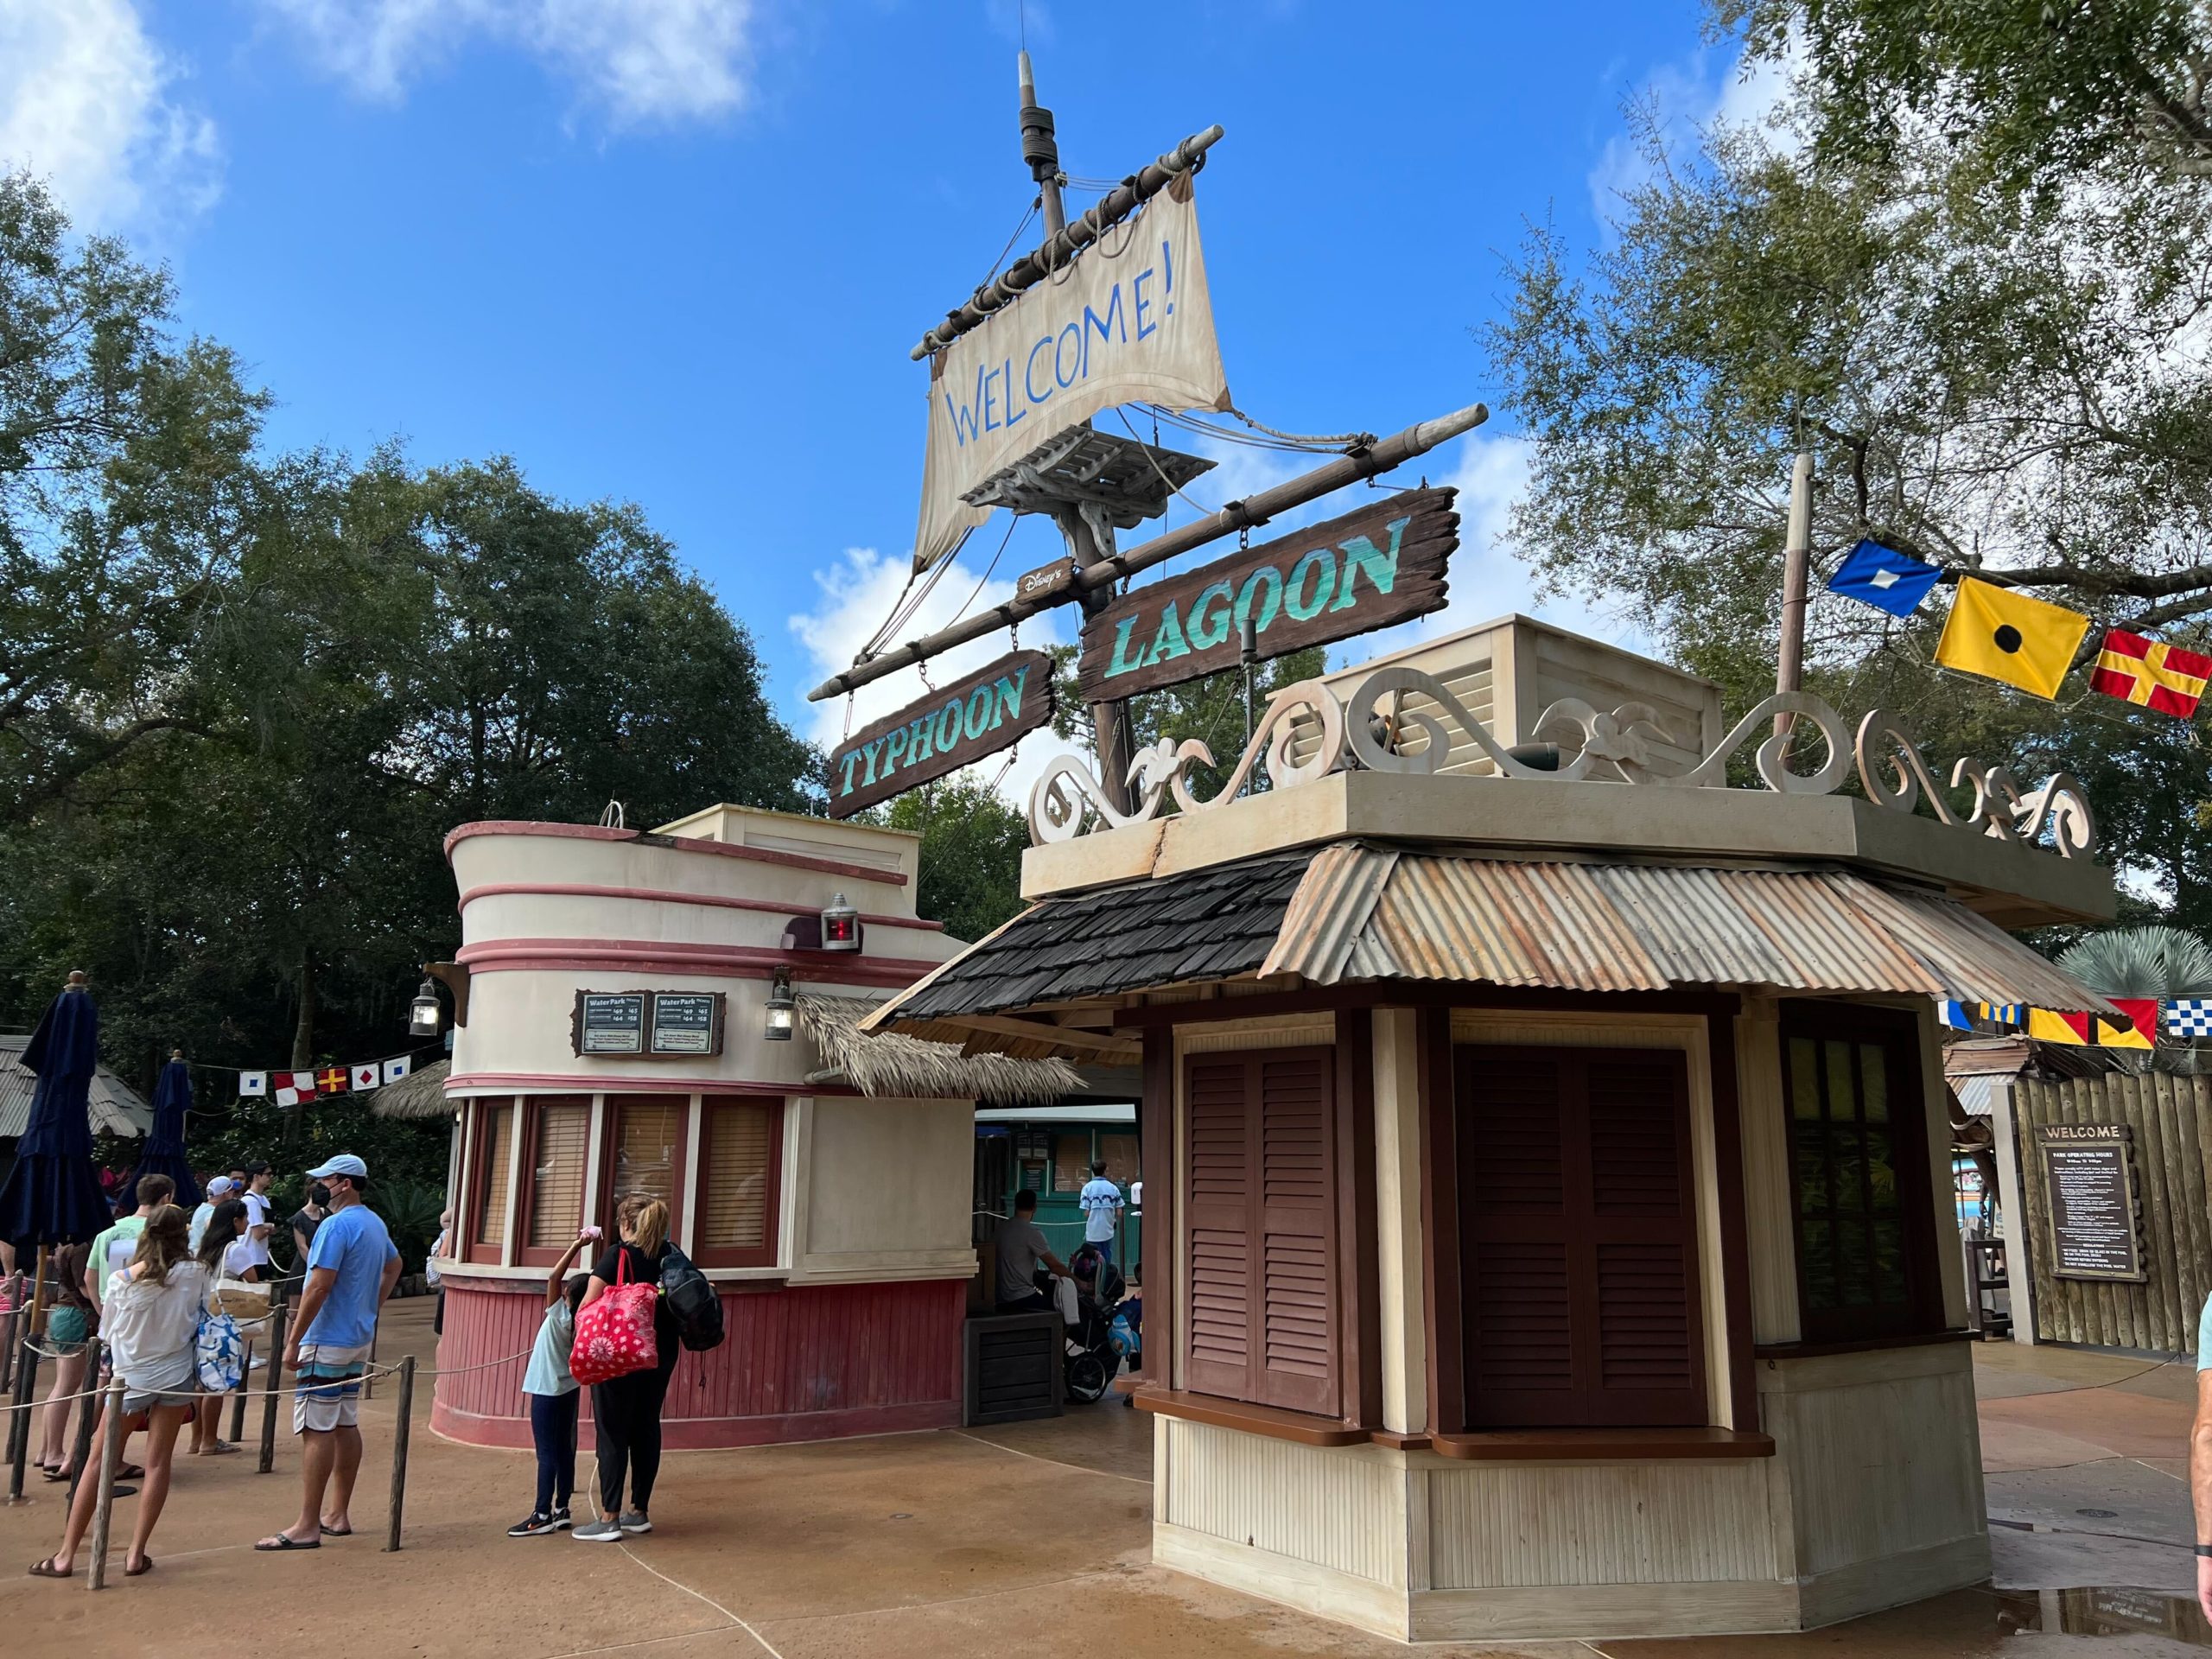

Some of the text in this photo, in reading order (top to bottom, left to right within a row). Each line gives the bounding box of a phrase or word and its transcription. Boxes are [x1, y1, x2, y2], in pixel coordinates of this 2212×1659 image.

[946, 241, 1173, 447] WELCOME!
[1103, 515, 1412, 679] LAGOON
[838, 664, 1030, 798] TYPHOON
[2045, 1126, 2120, 1138] WELCOME
